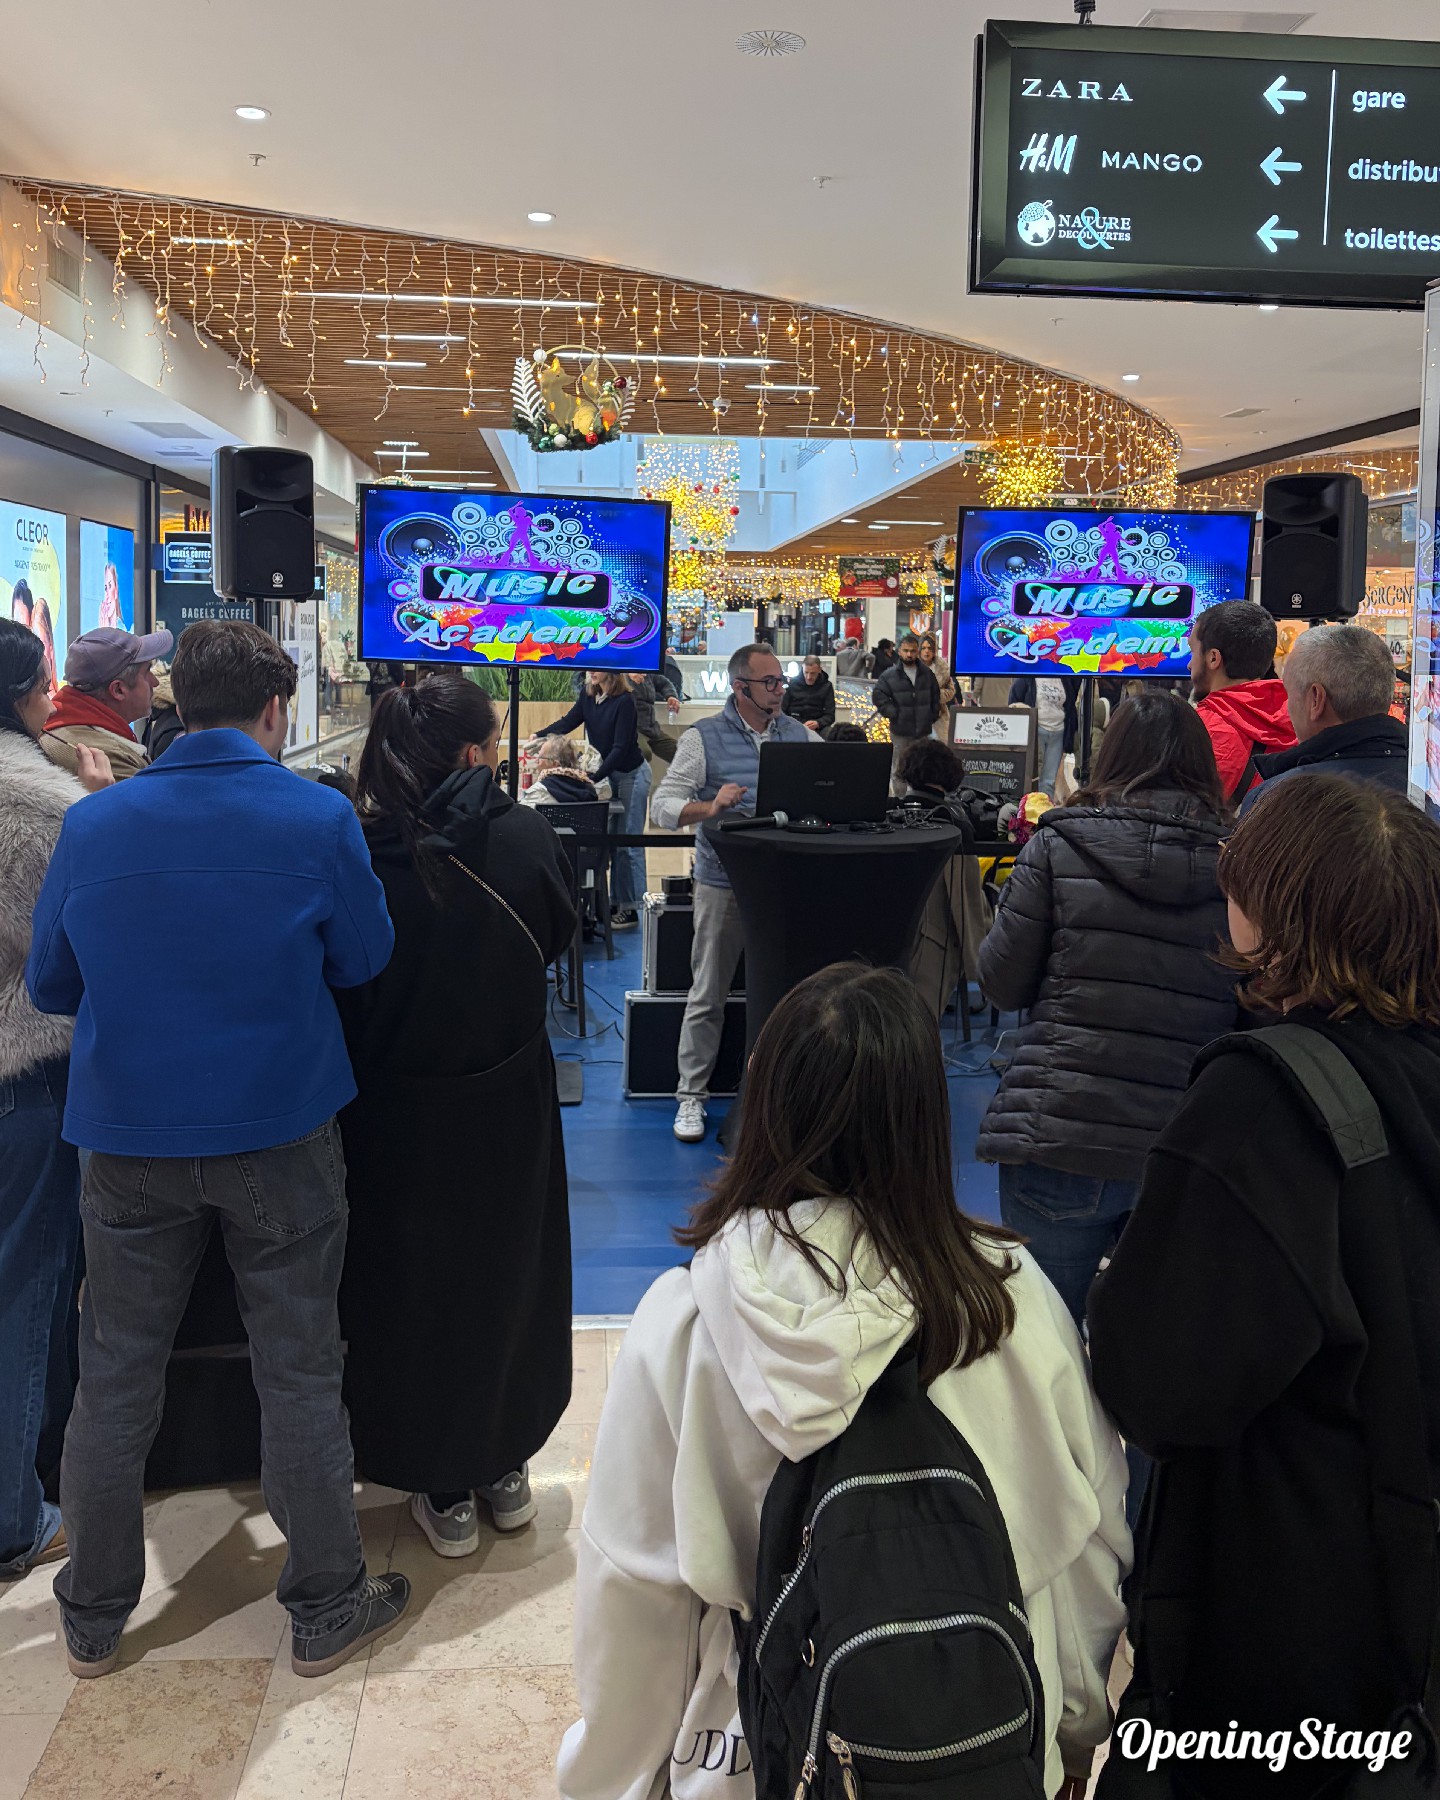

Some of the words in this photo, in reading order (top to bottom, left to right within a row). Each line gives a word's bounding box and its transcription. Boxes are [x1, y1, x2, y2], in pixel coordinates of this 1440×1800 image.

[1021, 78, 1133, 101] ZARA
[1352, 89, 1406, 113] gare
[1019, 132, 1078, 175] H&M
[1101, 150, 1202, 173] MANGO
[1348, 158, 1440, 184] distribu
[1345, 227, 1440, 252] toilettes
[16, 518, 49, 546] CLEOR
[169, 549, 190, 558] BAGELS
[191, 550, 211, 559] COFFEE
[439, 569, 597, 600] Music
[1028, 582, 1180, 615] Music
[181, 607, 215, 619] BAGELS
[404, 619, 626, 649] Academy
[994, 632, 1192, 659] Academy
